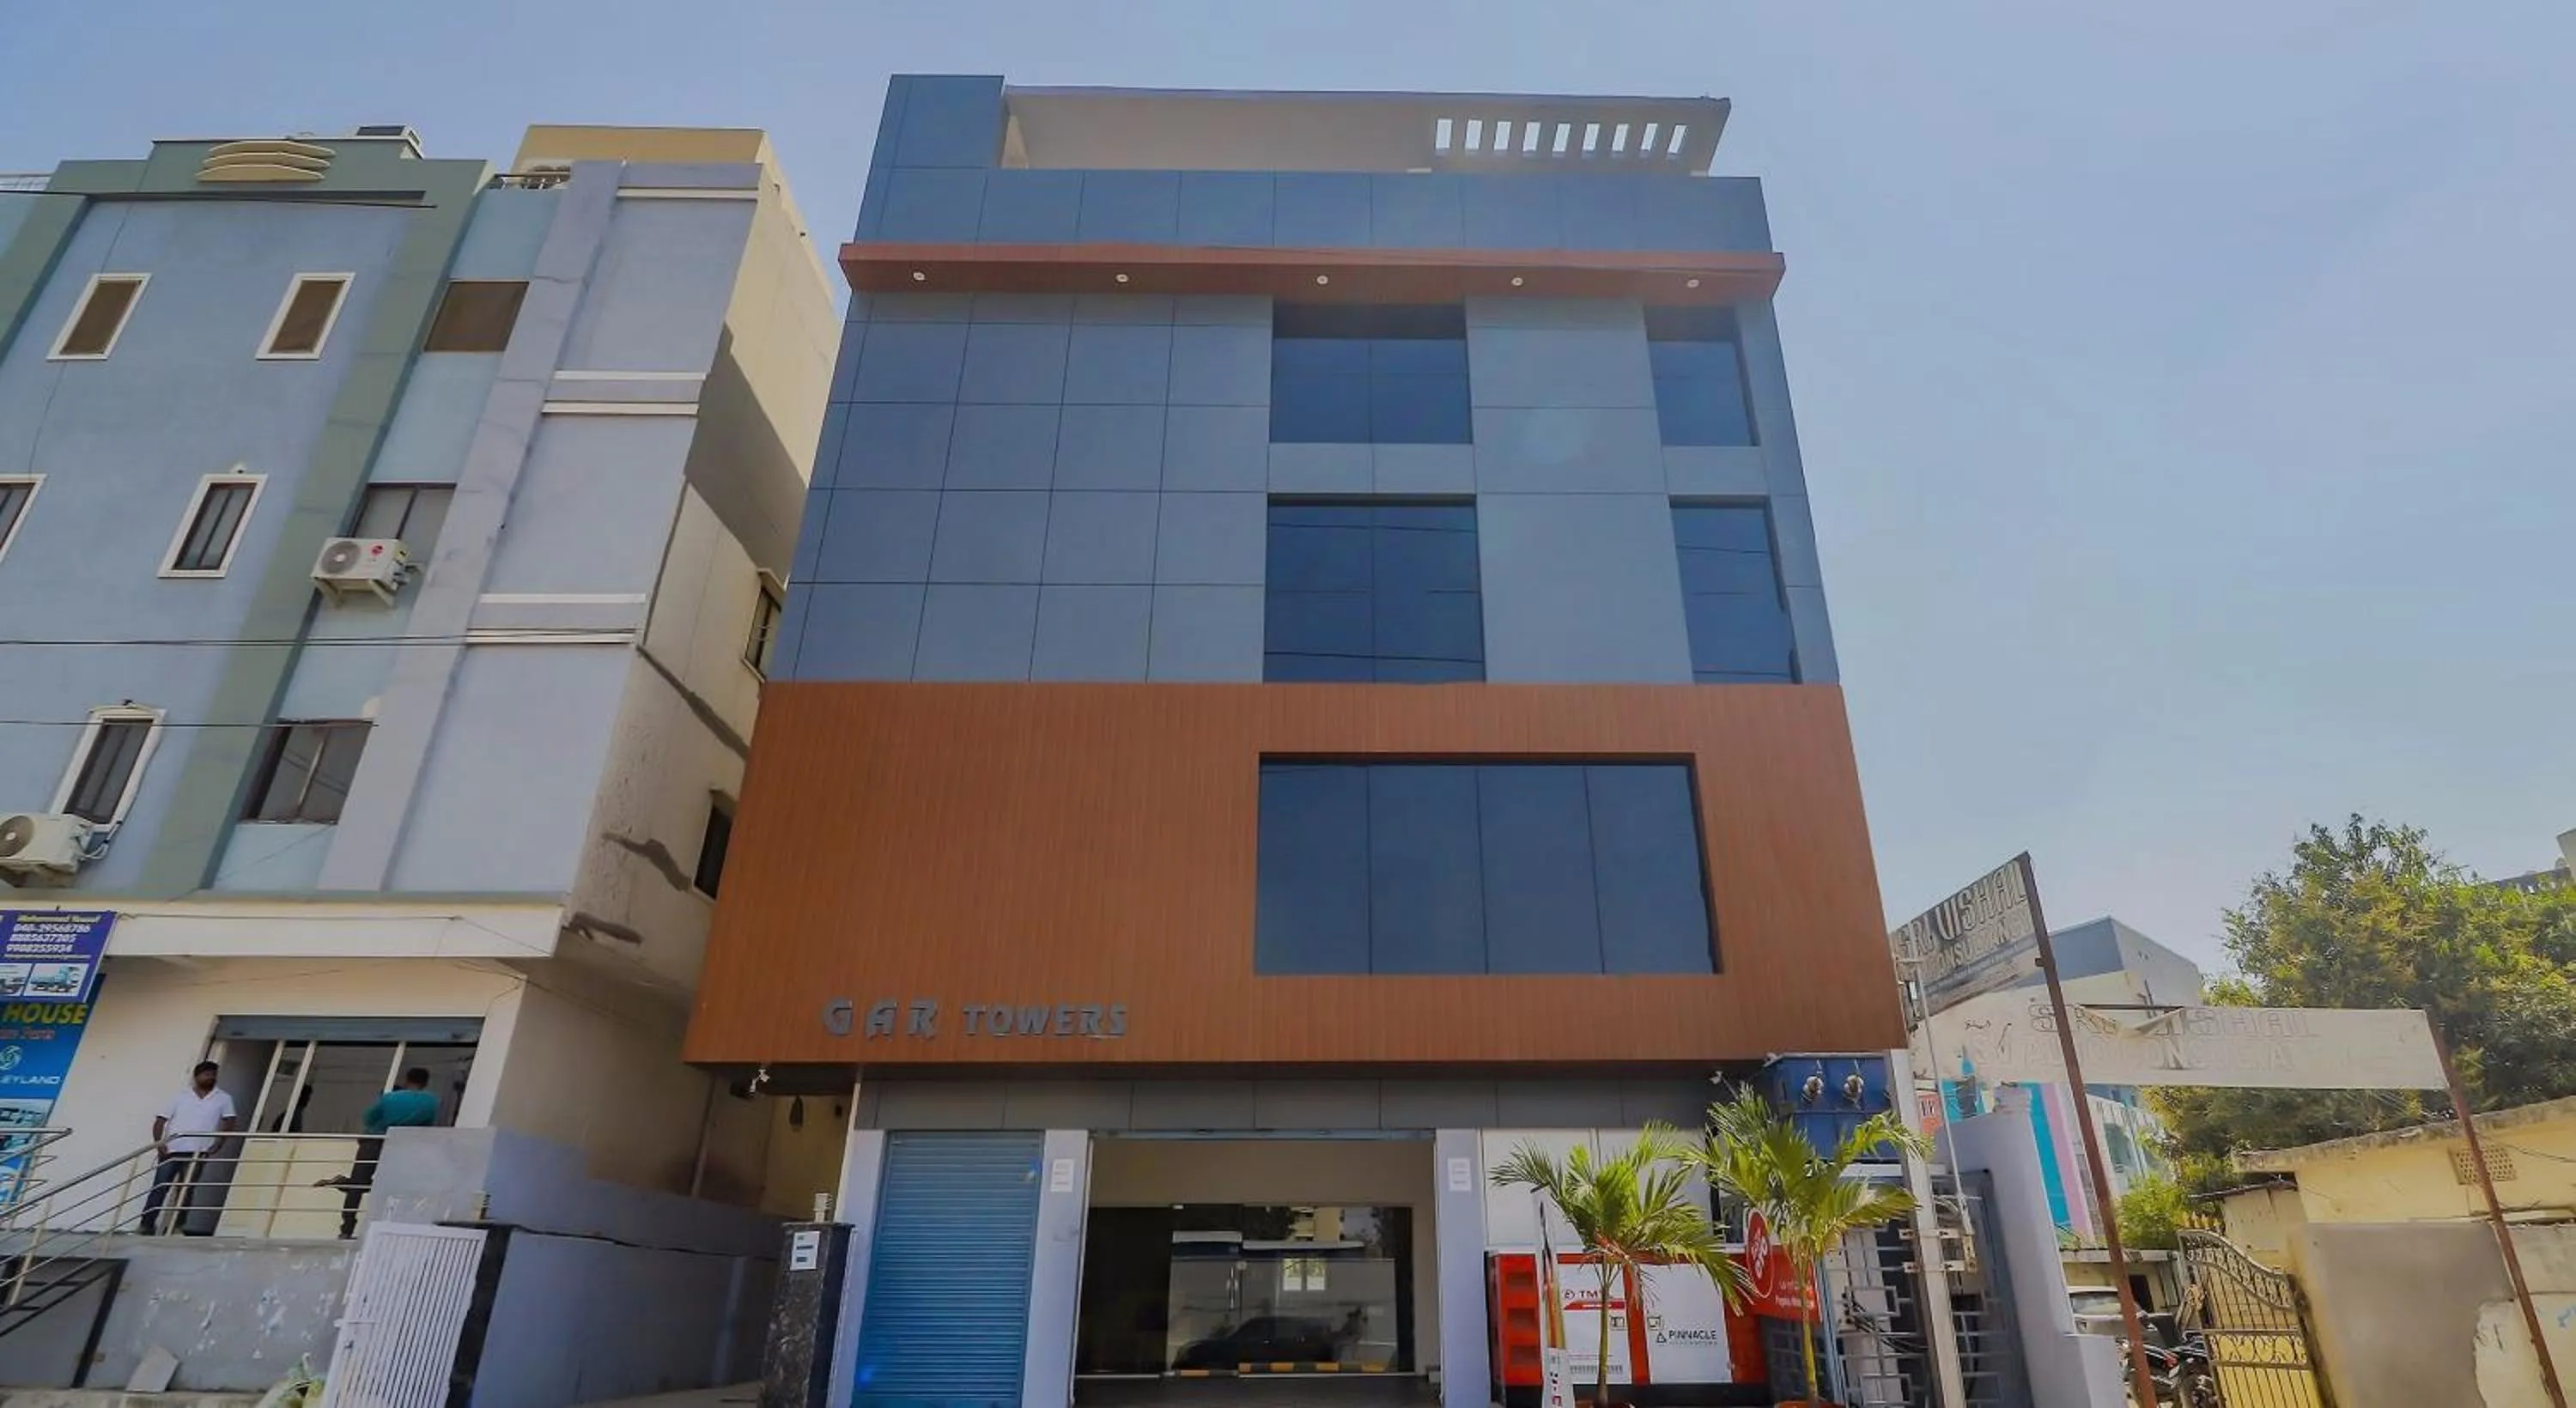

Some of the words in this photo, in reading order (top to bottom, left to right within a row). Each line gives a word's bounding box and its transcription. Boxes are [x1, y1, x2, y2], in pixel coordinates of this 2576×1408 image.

[3, 1003, 88, 1024] HOUSE
[823, 998, 938, 1041] GAR
[963, 1004, 1128, 1039] TOWERS
[1668, 1330, 1717, 1341] PINNACLE
